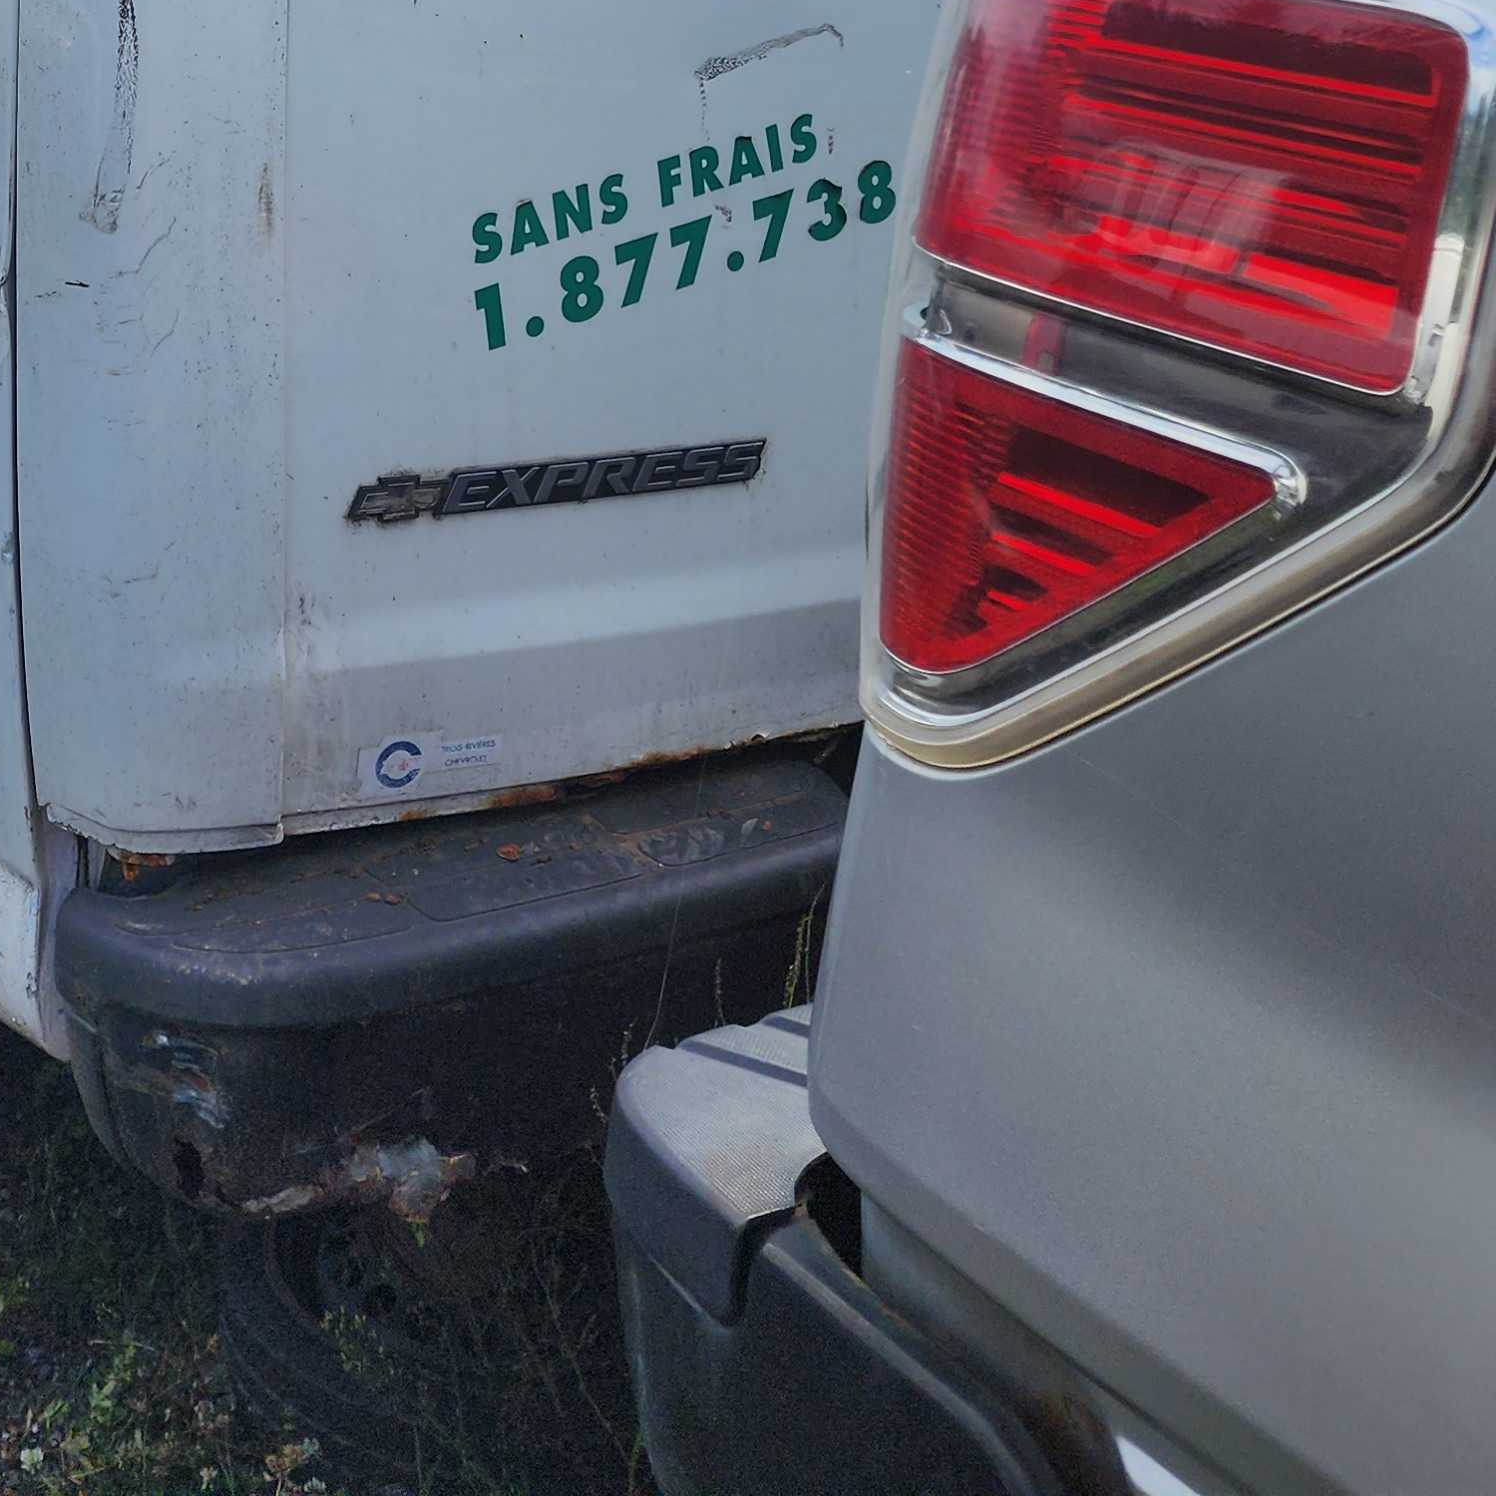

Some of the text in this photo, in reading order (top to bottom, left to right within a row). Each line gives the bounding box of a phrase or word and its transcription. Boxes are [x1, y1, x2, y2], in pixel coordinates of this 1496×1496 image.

[471, 113, 818, 264] SANS FRAIS
[474, 160, 897, 351] 1.877.738
[438, 440, 765, 515] EXPRESS
